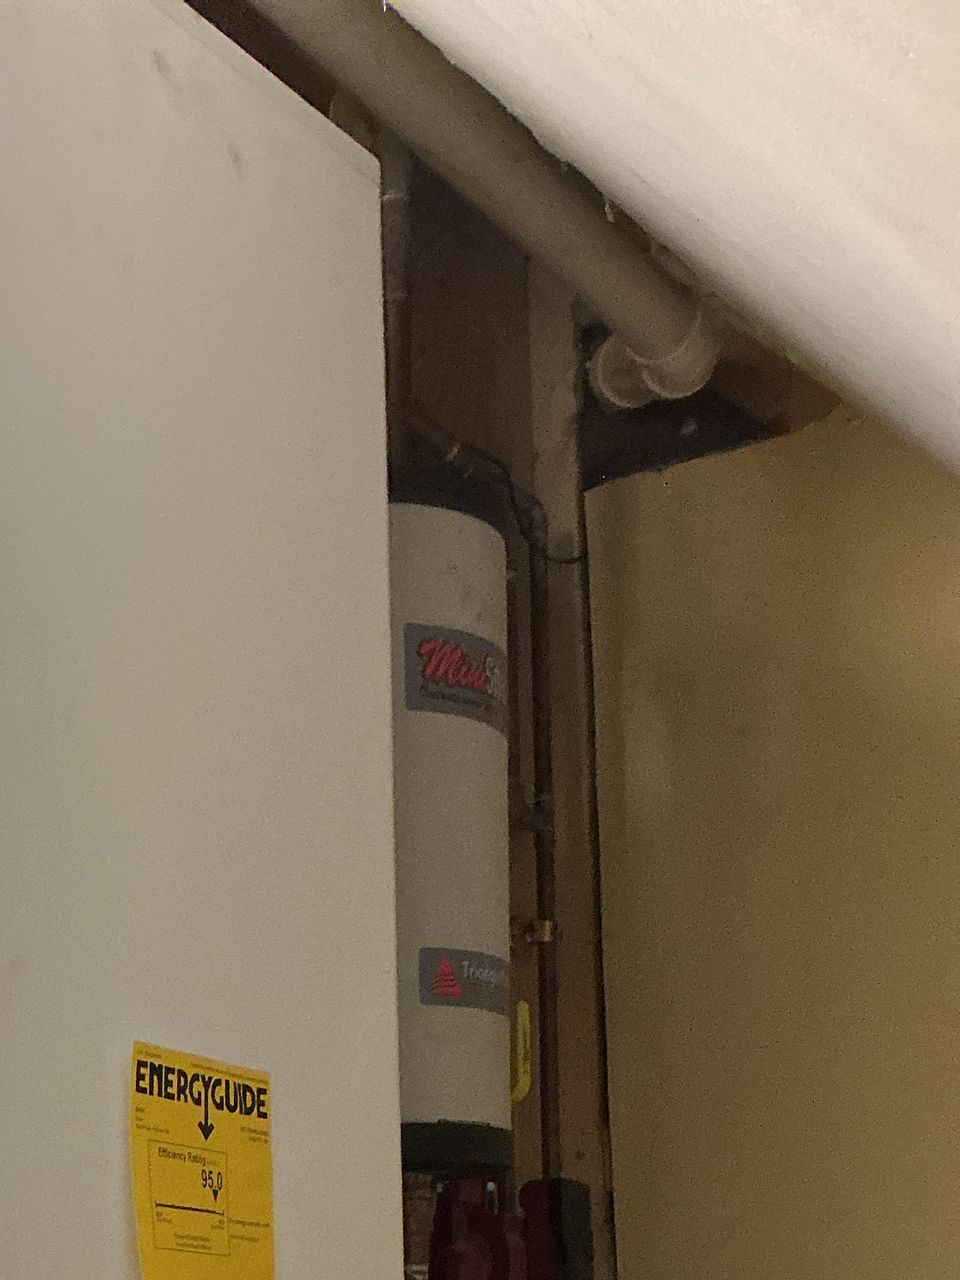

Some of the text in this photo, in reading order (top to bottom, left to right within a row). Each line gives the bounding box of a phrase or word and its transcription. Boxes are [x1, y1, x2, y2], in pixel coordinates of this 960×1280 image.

[135, 1059, 268, 1119] ENERGYGUIDE
[157, 1147, 206, 1167] Efficiency Rating
[201, 1169, 223, 1191] 95.0
